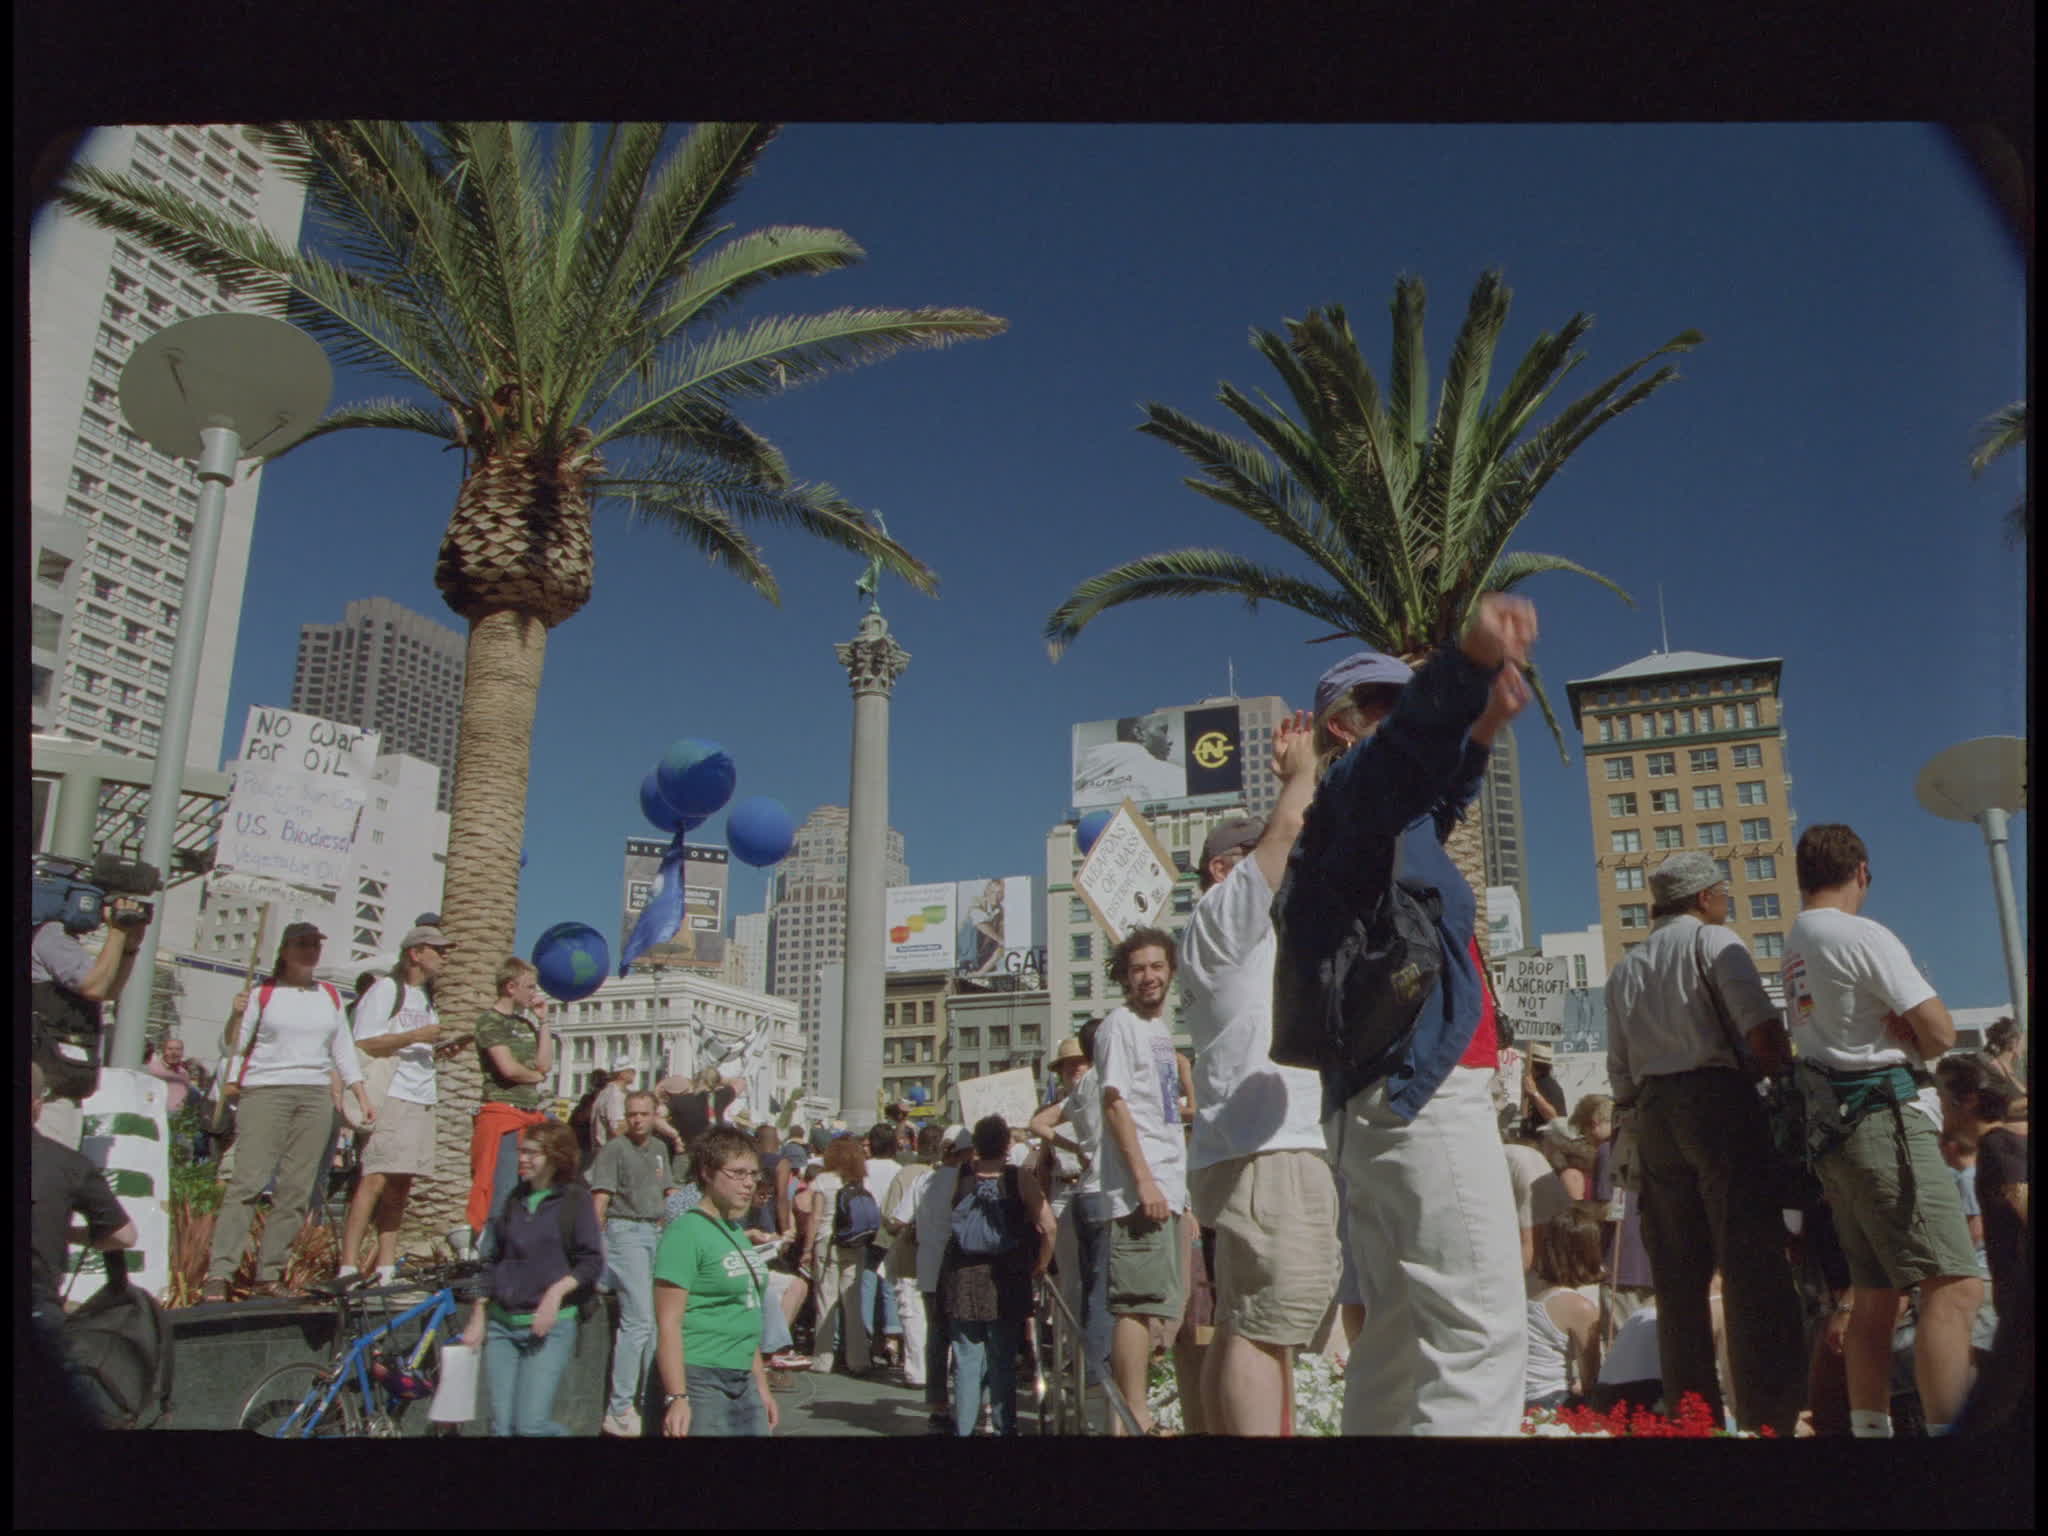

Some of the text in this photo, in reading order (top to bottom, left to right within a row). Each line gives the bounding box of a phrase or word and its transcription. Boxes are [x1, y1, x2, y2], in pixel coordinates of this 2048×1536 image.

[257, 711, 364, 753] NO War
[1102, 868, 1117, 893] OF
[1519, 960, 1554, 976] DROP
[1506, 976, 1564, 994] ASHCROFT
[1518, 996, 1547, 1010] NOT
